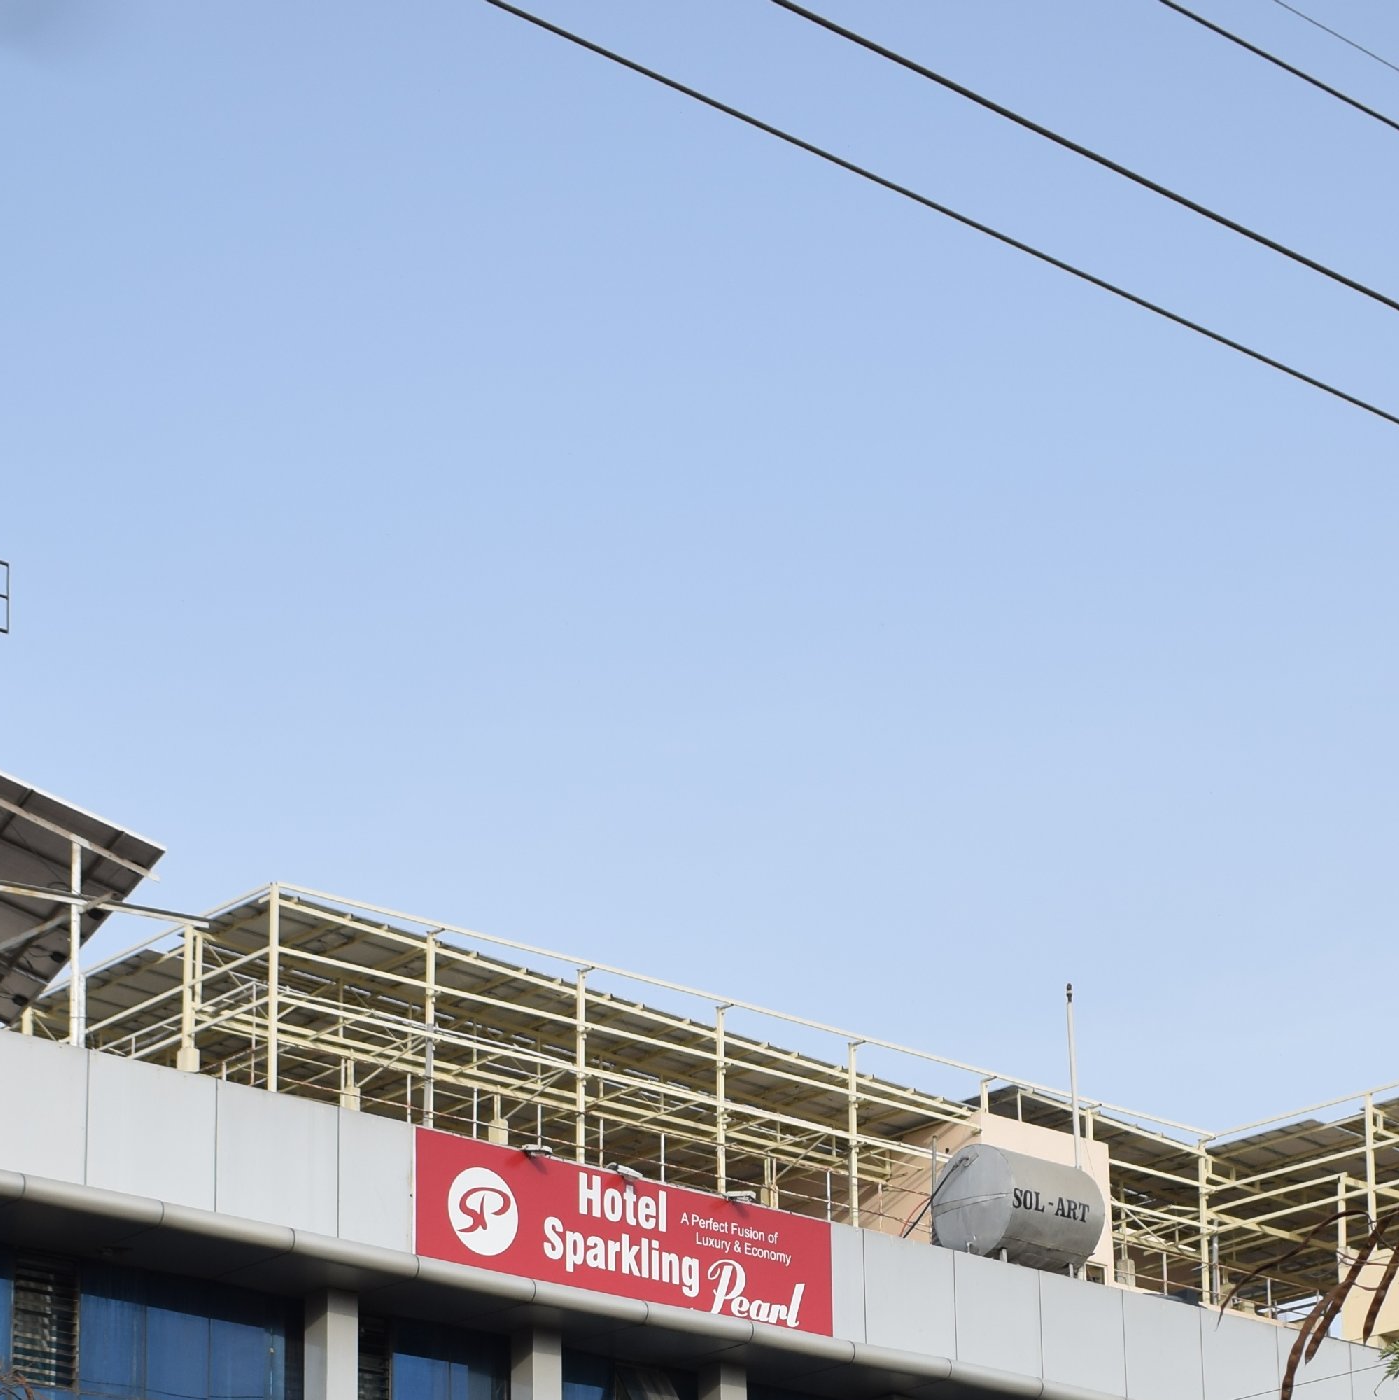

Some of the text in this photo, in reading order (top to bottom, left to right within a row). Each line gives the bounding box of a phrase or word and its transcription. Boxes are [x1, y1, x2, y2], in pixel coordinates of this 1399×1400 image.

[578, 1172, 667, 1232] Hotel
[680, 1212, 779, 1244] A Perfect Fusion of
[543, 1216, 700, 1298] Sparkling
[696, 1232, 792, 1267] Luxury & Economy
[707, 1259, 805, 1328] Pearl
